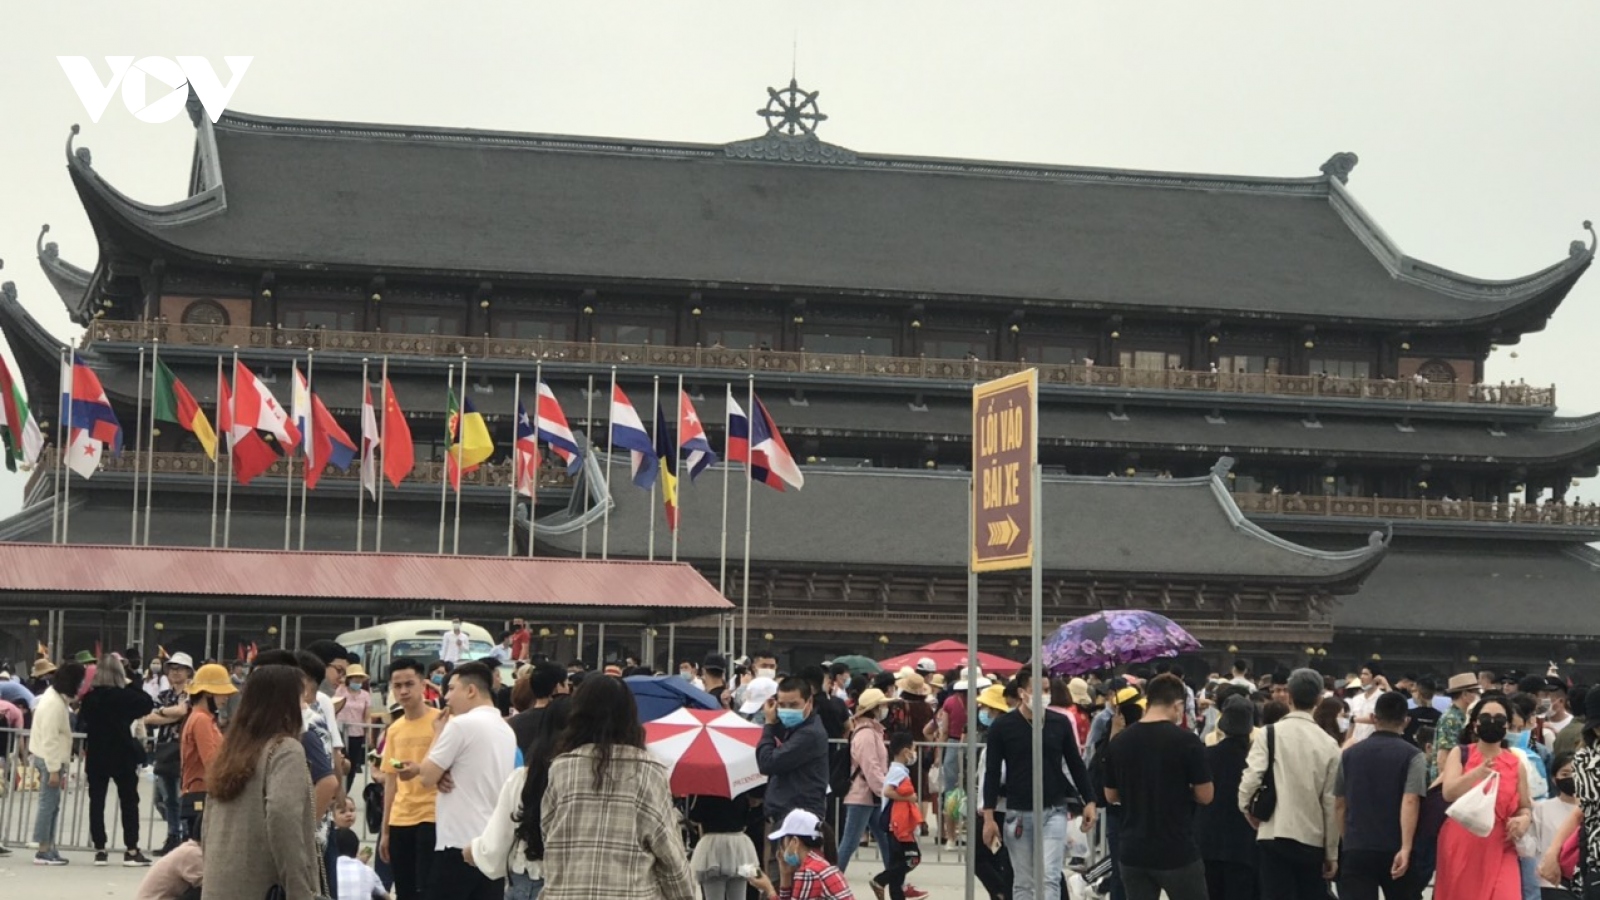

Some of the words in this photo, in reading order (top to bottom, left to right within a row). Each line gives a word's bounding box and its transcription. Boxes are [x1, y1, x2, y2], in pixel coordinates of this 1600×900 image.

[981, 398, 998, 457] LỐI
[1000, 399, 1023, 452] VÀO
[1004, 462, 1020, 506] XE
